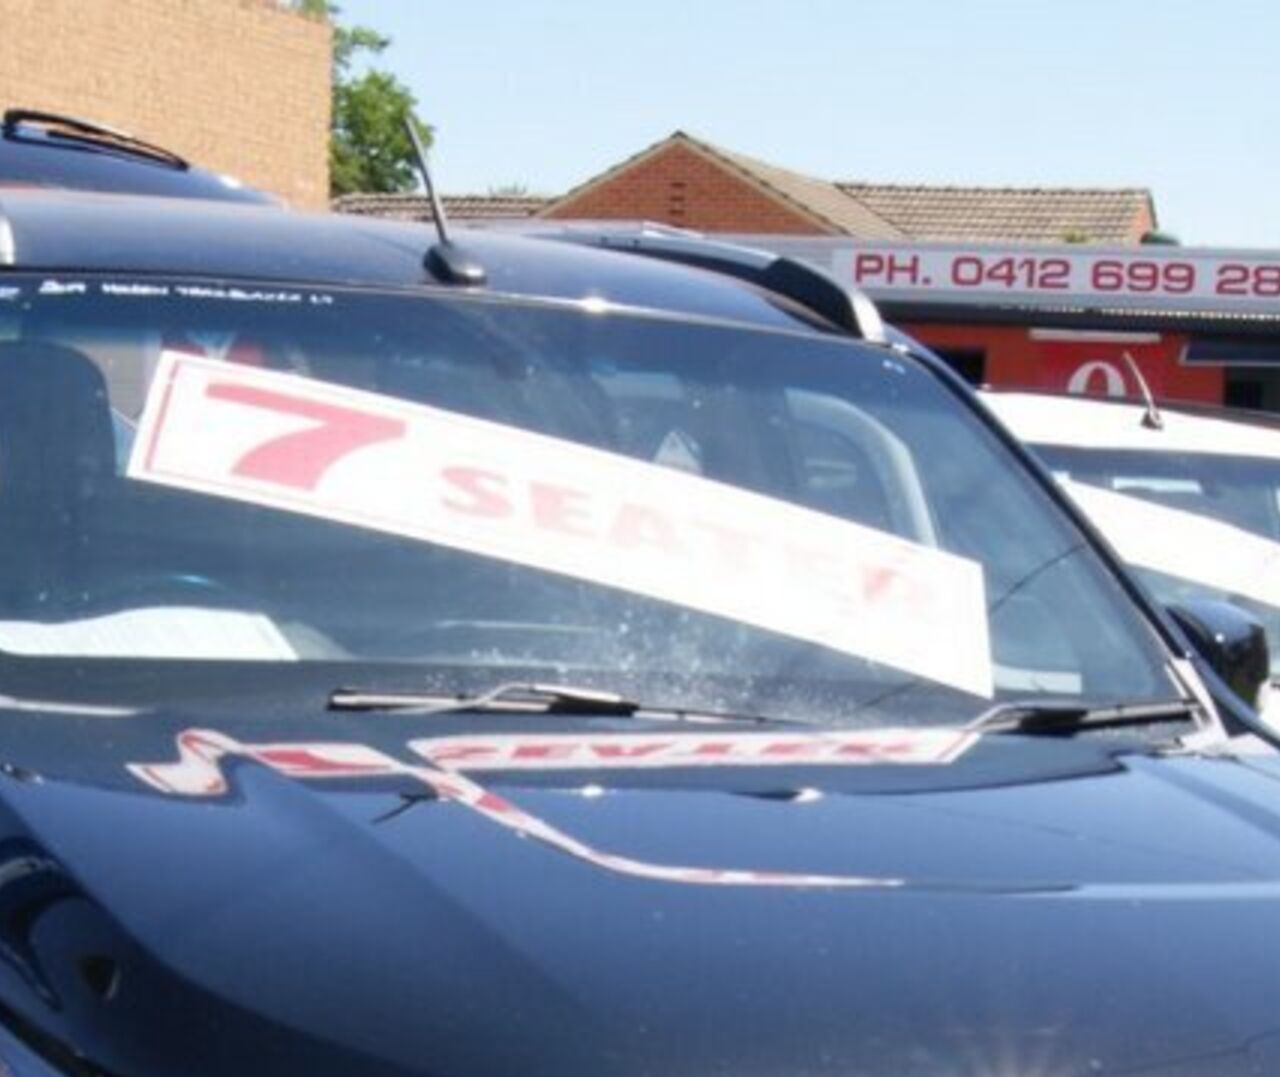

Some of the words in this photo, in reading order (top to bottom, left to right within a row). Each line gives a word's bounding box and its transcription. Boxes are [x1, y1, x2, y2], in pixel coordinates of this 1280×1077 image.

[854, 254, 931, 285] PH.
[951, 256, 1072, 289] 0412
[1092, 260, 1195, 292] 699
[205, 381, 407, 491] 7
